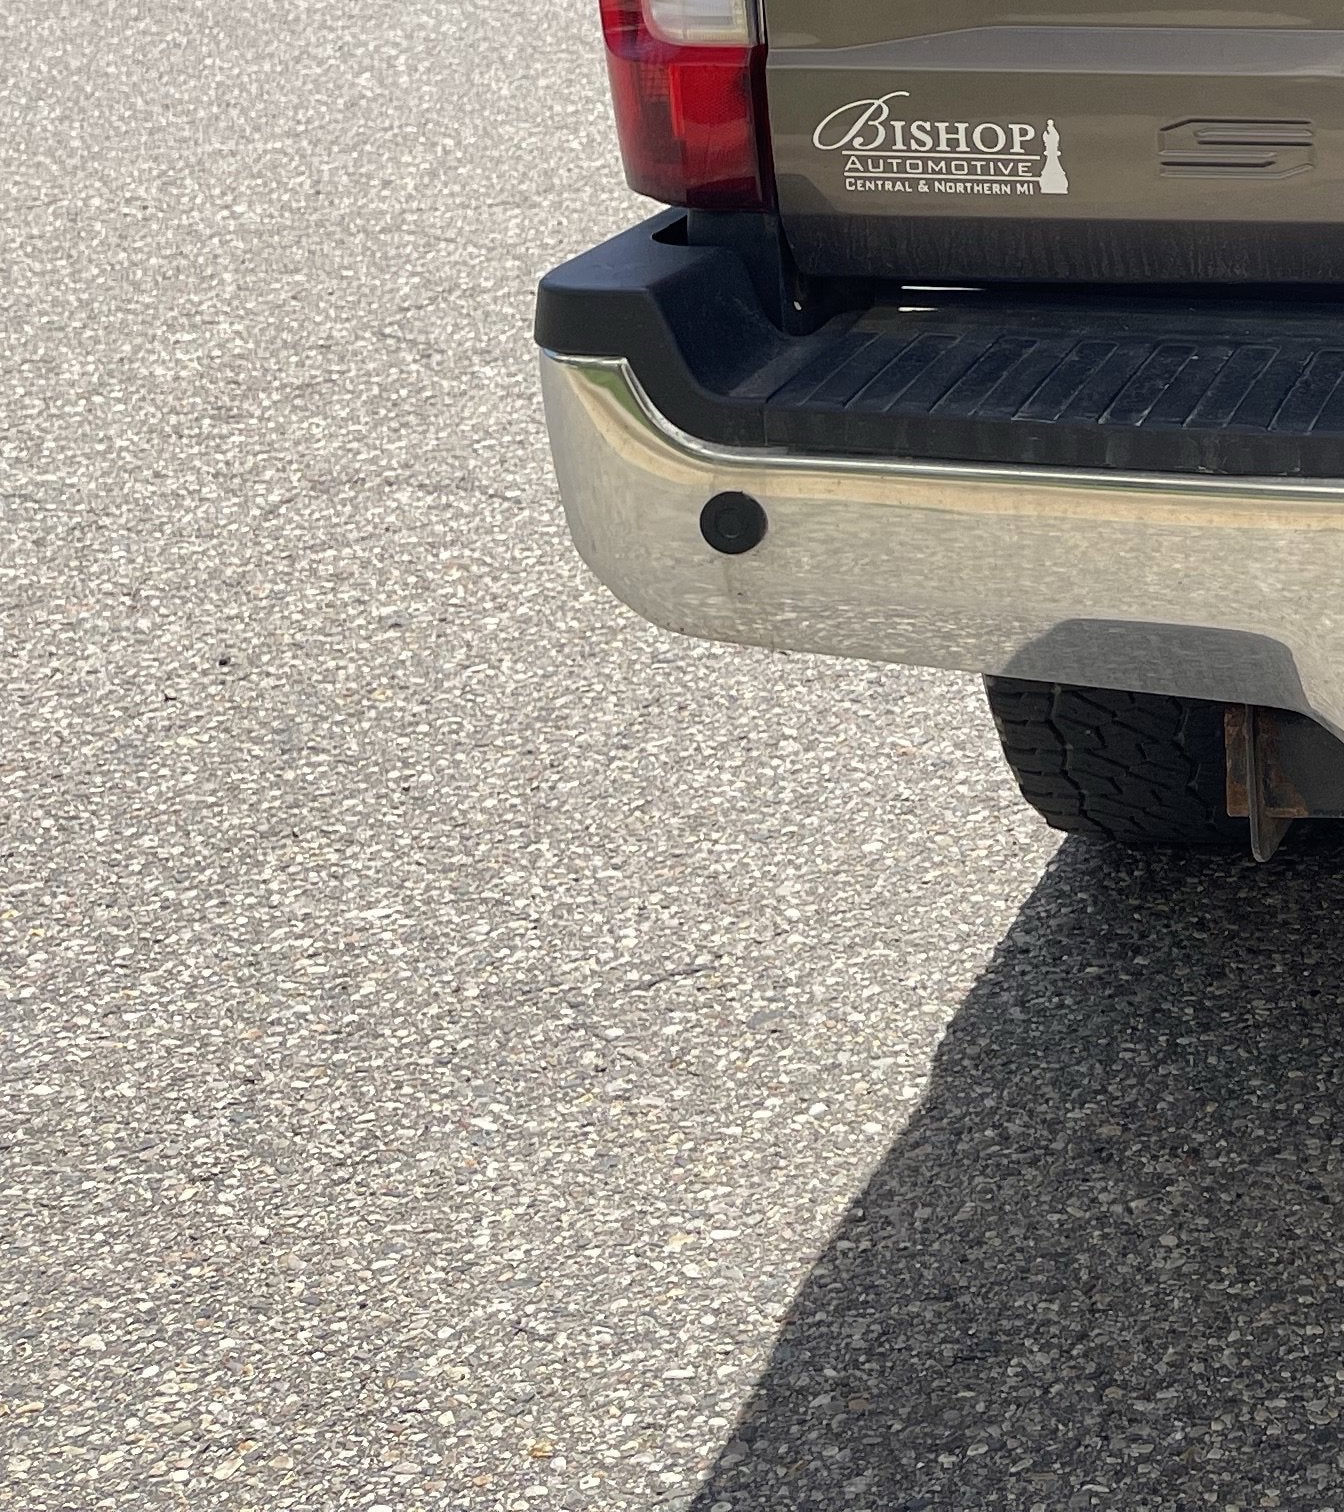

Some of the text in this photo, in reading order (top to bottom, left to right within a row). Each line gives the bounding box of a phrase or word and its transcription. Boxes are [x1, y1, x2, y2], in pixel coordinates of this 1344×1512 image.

[812, 90, 1036, 153] BISHOP
[844, 155, 1034, 177] AUTOMOTIVE
[844, 178, 1035, 195] CENTRAL & NORTHERN MI
